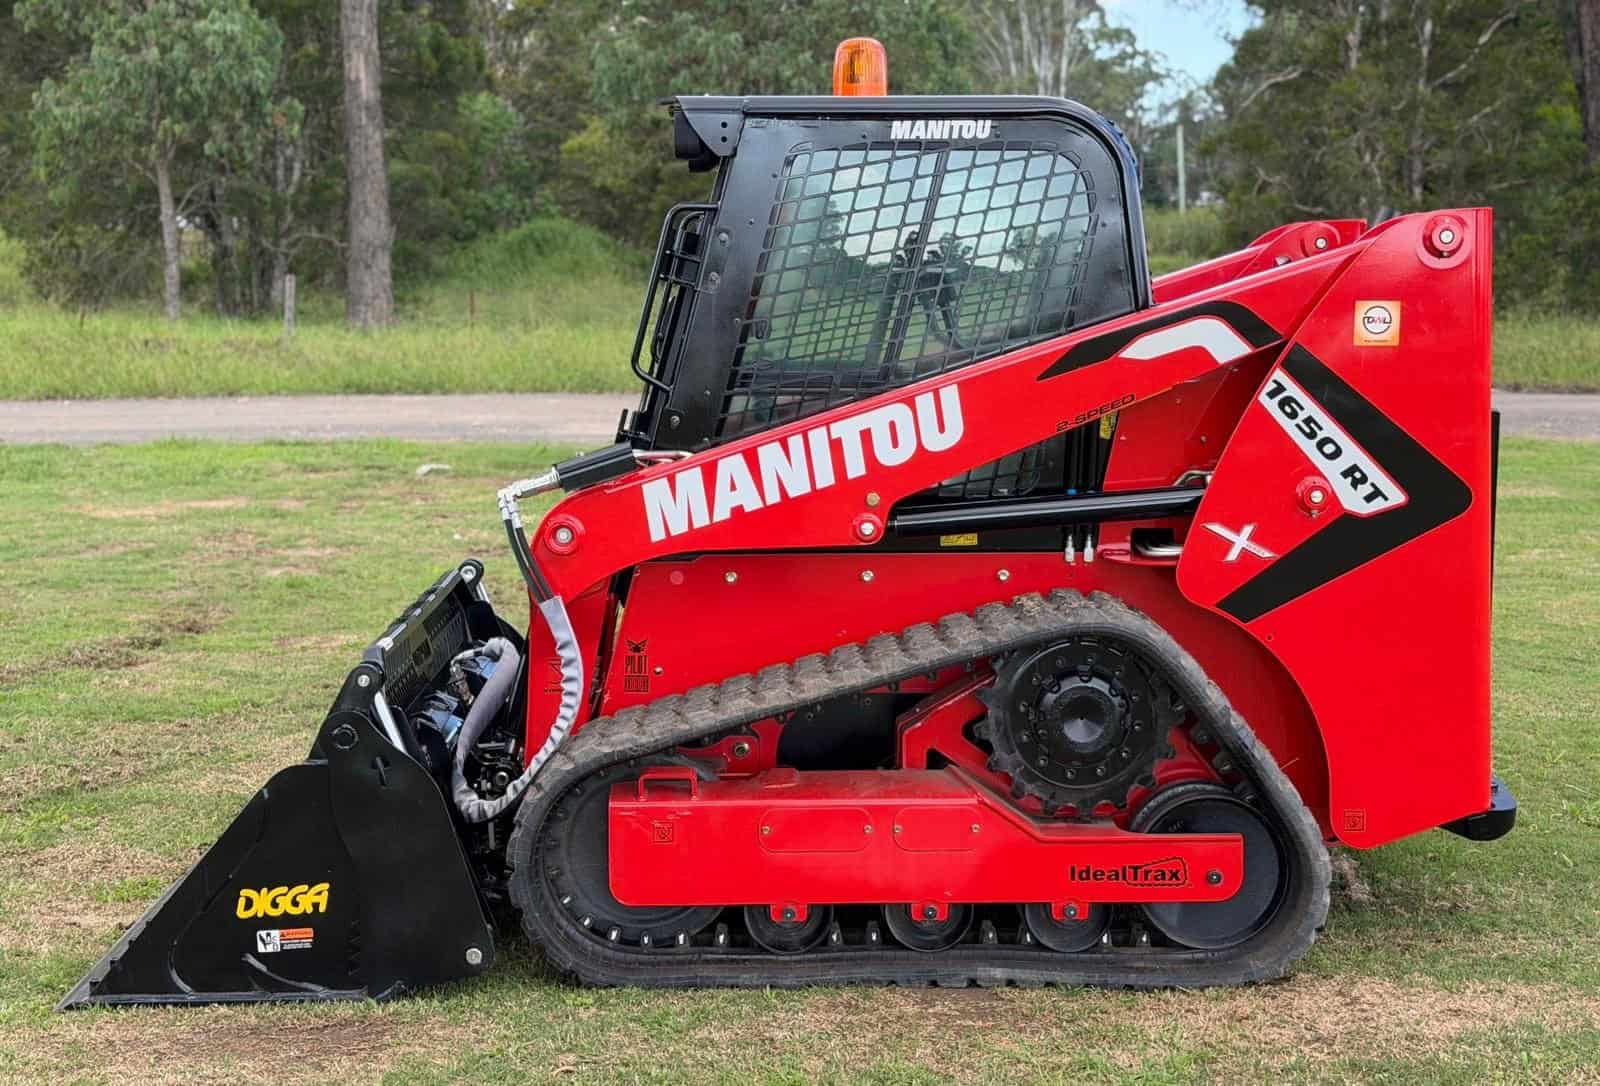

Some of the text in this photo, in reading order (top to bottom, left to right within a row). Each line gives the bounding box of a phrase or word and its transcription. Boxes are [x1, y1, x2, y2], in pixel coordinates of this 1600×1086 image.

[890, 120, 992, 139] MANITOU
[1056, 393, 1135, 432] 2-SPEED
[1265, 379, 1388, 504] 1650 RT
[642, 384, 964, 542] MANITOU
[1070, 860, 1186, 885] IdealTrax
[236, 882, 330, 919] DIGGA
